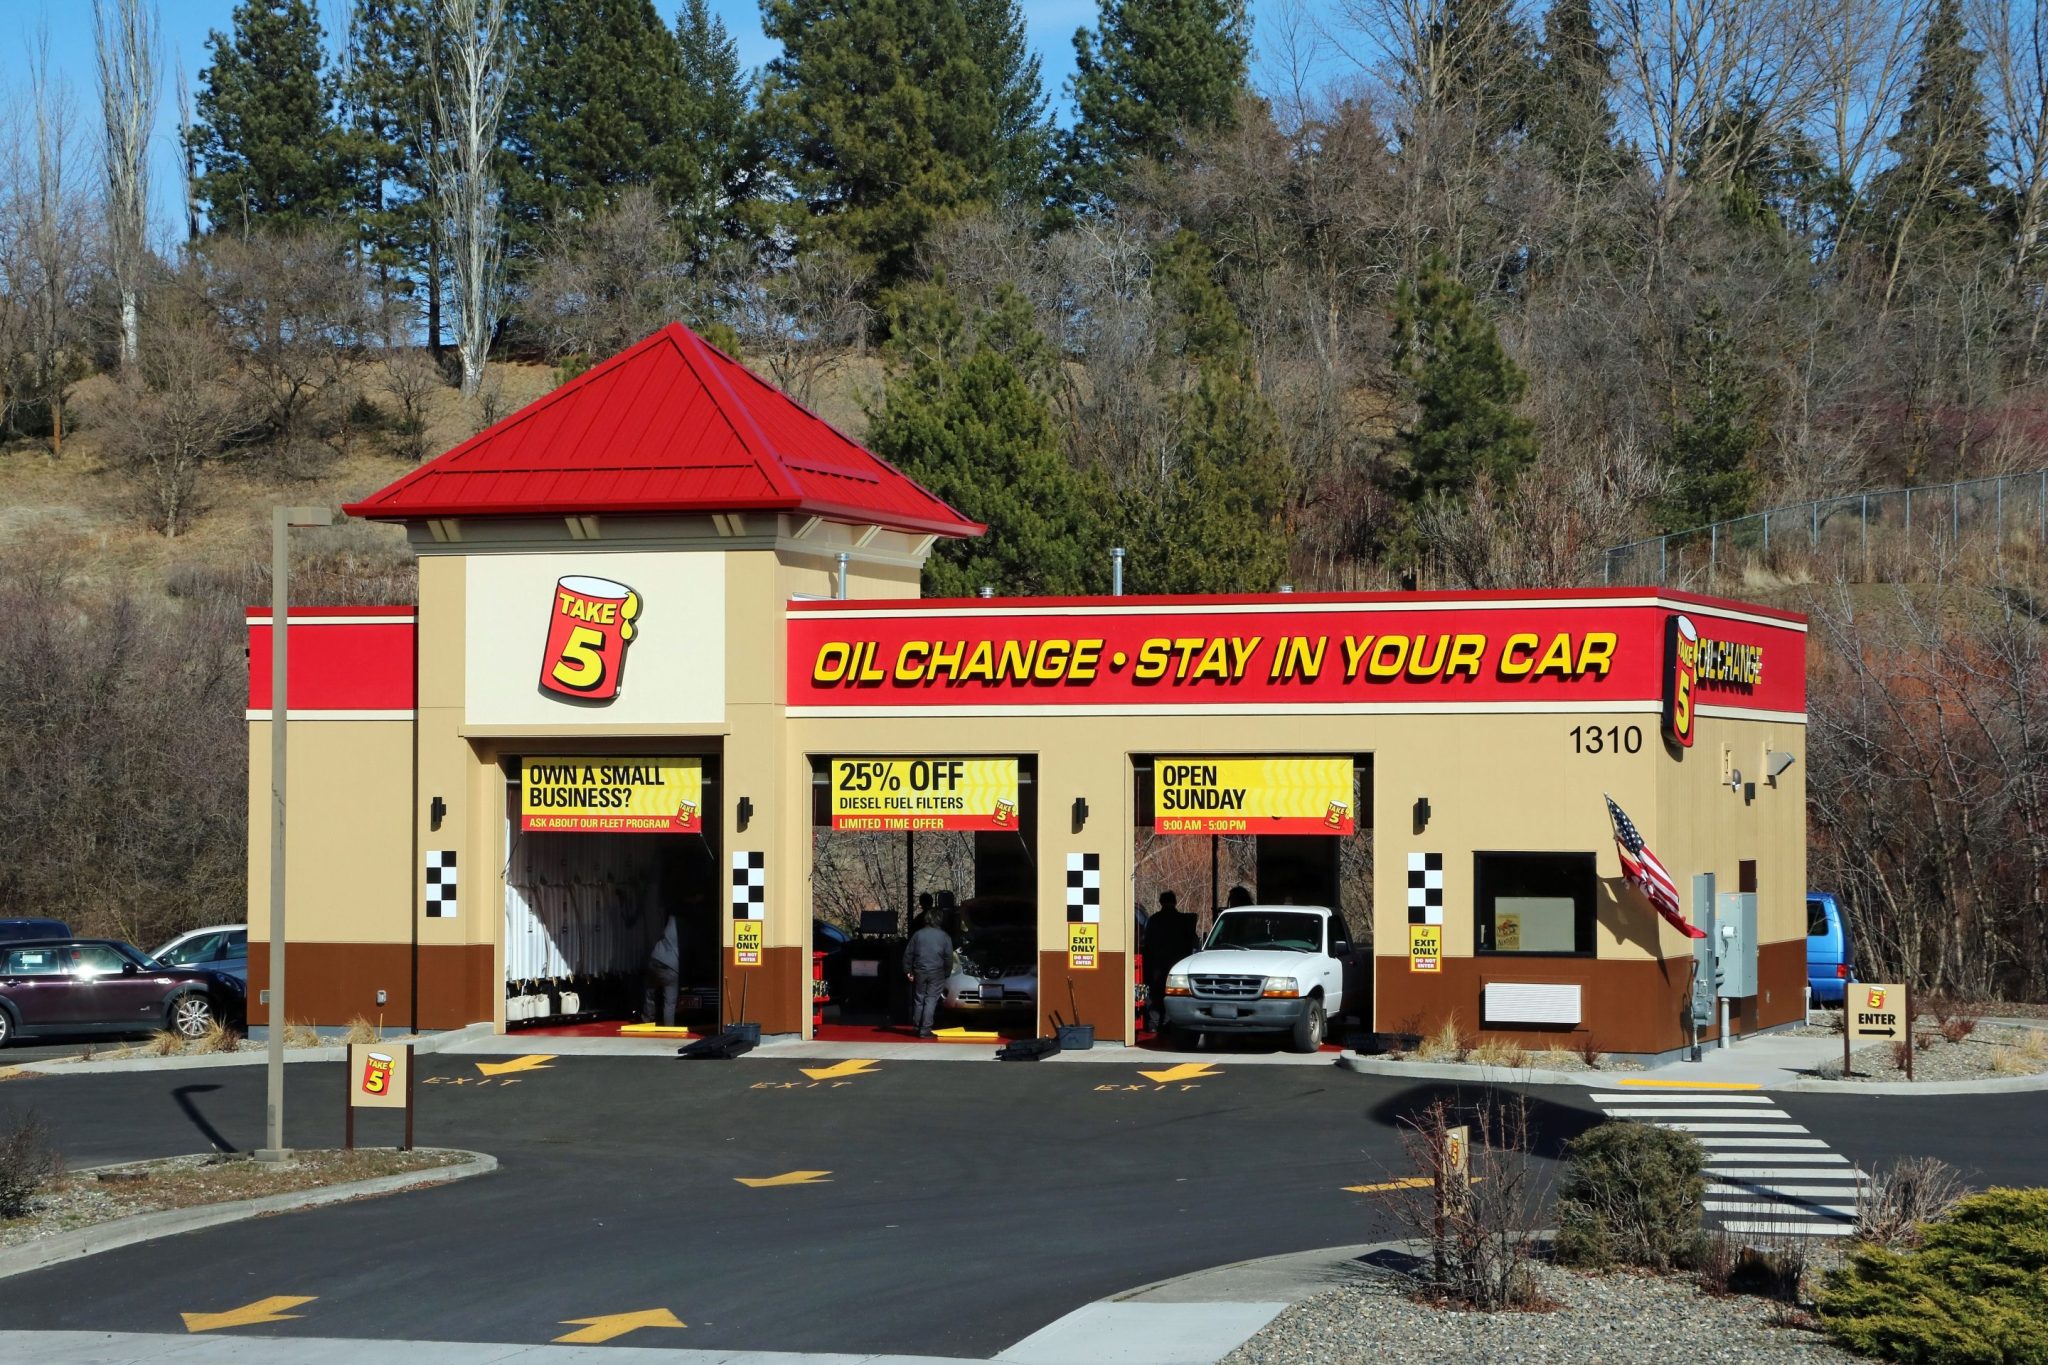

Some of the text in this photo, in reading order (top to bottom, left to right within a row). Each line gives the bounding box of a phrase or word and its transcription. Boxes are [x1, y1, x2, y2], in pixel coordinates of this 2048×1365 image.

[559, 592, 618, 625] TAKE
[1677, 632, 1694, 668] TAKE
[551, 625, 606, 689] 5
[812, 641, 886, 684] OIL
[894, 638, 1104, 684] CHANGE
[1135, 636, 1262, 681] STAY
[1270, 636, 1328, 679] IN
[1343, 634, 1487, 680] YOUR
[1499, 632, 1618, 677] CAR
[1717, 640, 1763, 685] CHANGE
[1675, 670, 1690, 735] 5
[1569, 725, 1642, 755] 1310
[529, 764, 665, 786] OWN A SMALL
[839, 760, 964, 791] 25% OFF
[1162, 765, 1217, 786] OPEN
[529, 787, 633, 808] BUSINESS?
[839, 797, 964, 809] DIESEL FUEL FILTERS
[1162, 788, 1246, 810] SUNDAY
[679, 802, 694, 813] TAKE
[997, 801, 1012, 812] TAKE
[1328, 803, 1344, 815] TAKE
[679, 812, 690, 822] 5
[997, 811, 1007, 821] 5
[1329, 813, 1340, 824] 5
[529, 818, 547, 828] ASK
[549, 818, 578, 828] ABOUT
[580, 818, 598, 828] OUR
[600, 819, 623, 828] FLEET
[626, 819, 670, 829] PROGRAM
[839, 818, 944, 829] LIMITED TIME OFFER
[1163, 820, 1183, 831] 9:00
[1184, 820, 1202, 831] AM
[1208, 820, 1228, 831] 5:00
[1229, 820, 1246, 831] PM
[736, 942, 759, 950] ONLY
[1072, 936, 1094, 944] EXIT
[1414, 939, 1436, 947] EXIT
[1412, 947, 1438, 955] ONLY
[1869, 995, 1881, 1008] 5
[1858, 1013, 1896, 1025] ENTER
[368, 1058, 389, 1070] TAKE
[366, 1070, 385, 1093] 5
[422, 1076, 522, 1086] EXIT
